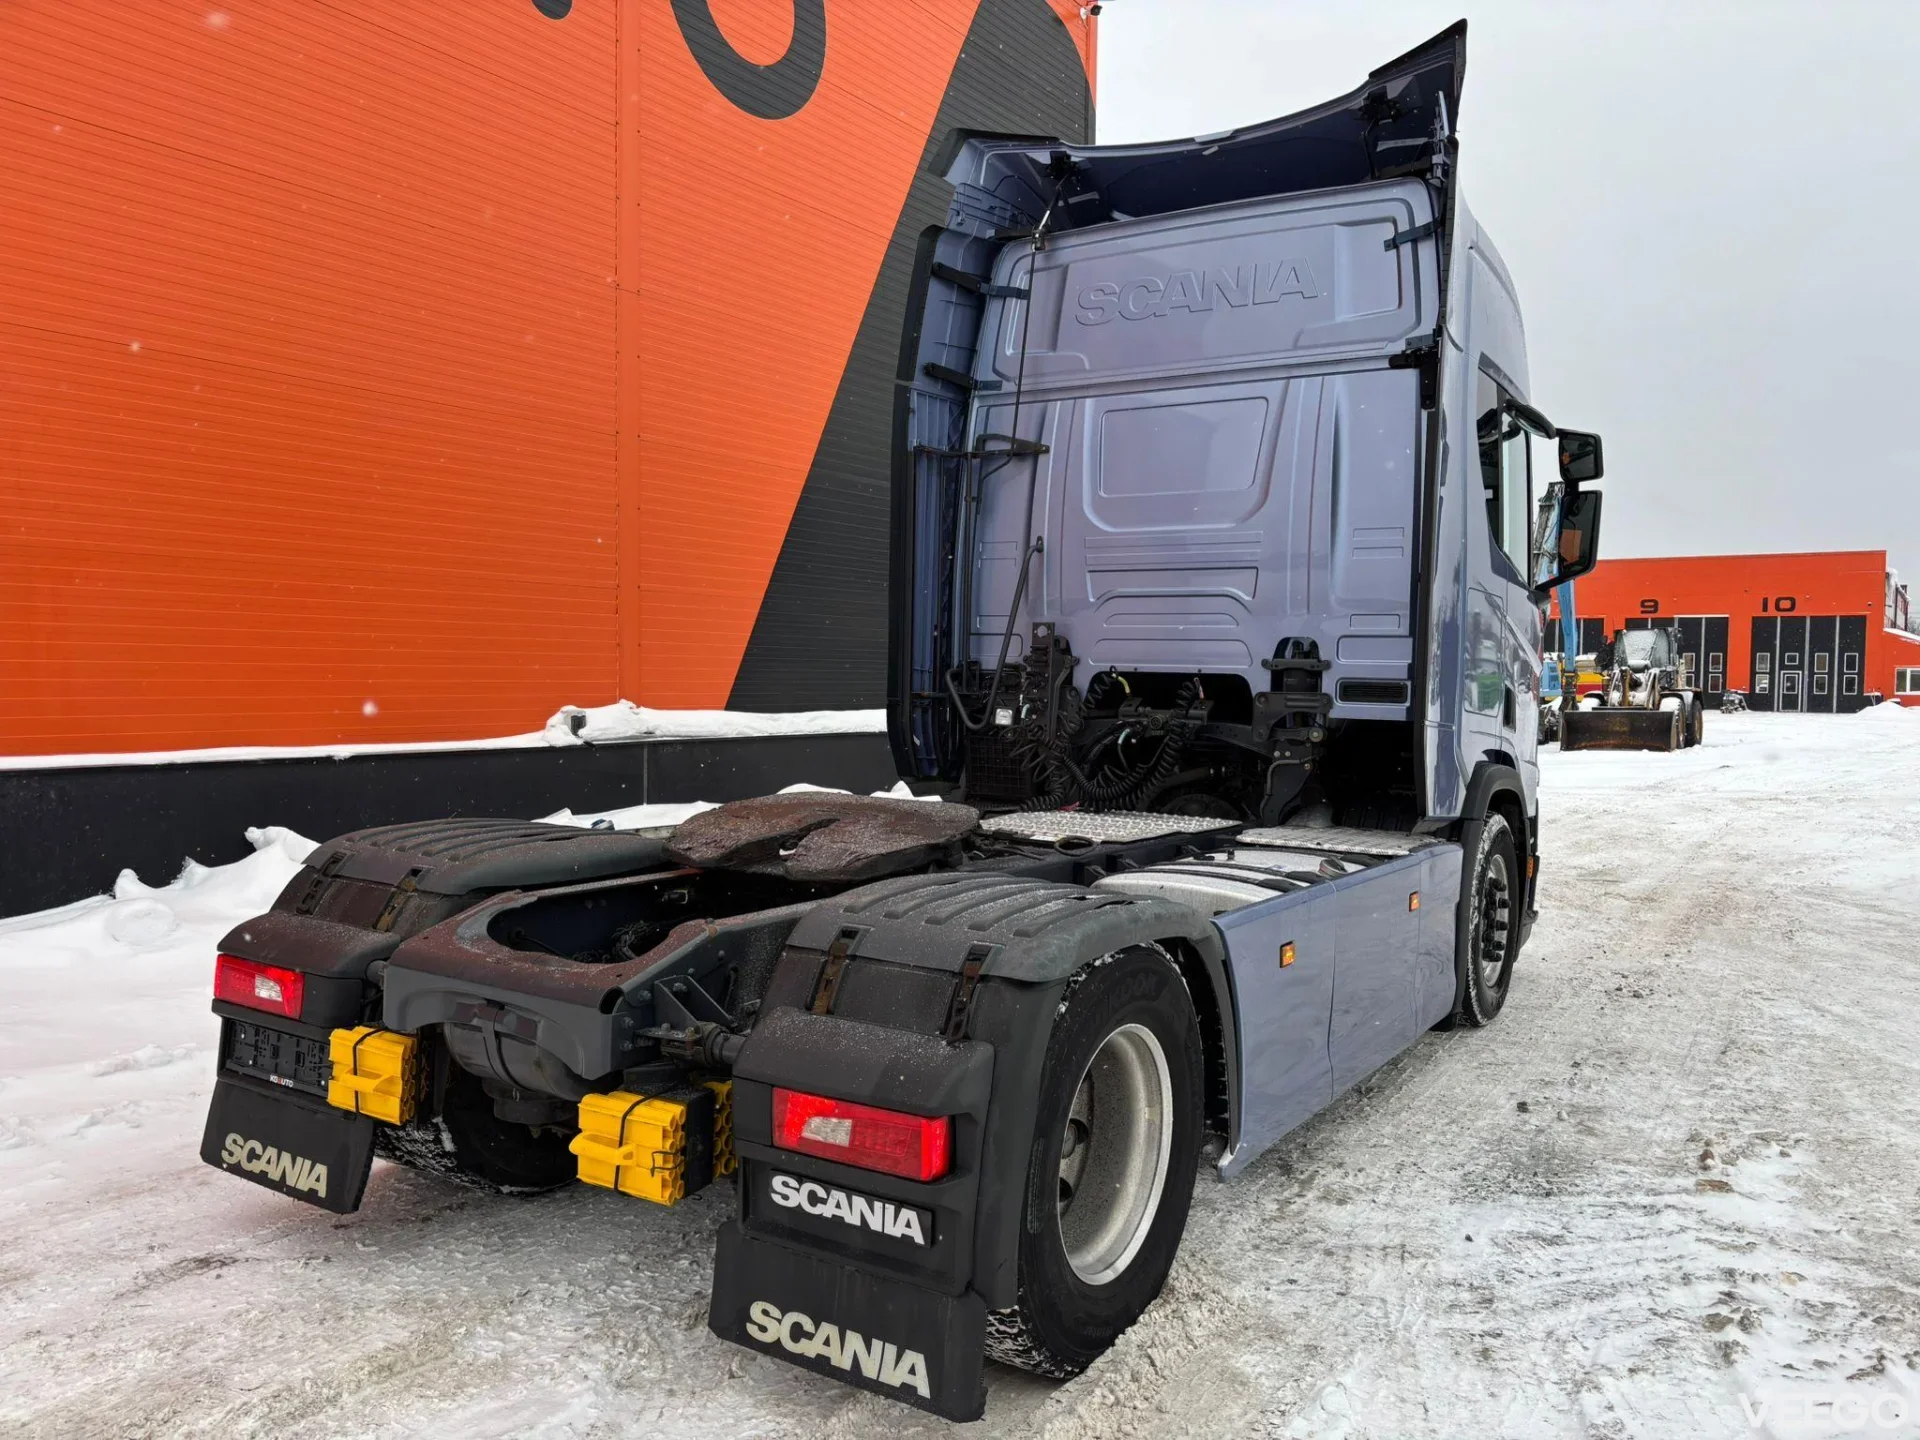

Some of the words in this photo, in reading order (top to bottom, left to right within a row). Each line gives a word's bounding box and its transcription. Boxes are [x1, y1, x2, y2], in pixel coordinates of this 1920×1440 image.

[1075, 257, 1319, 326] SCANIA
[1640, 598, 1659, 614] 9
[1761, 596, 1796, 613] 10
[221, 1132, 328, 1198] SCANIA
[770, 1175, 925, 1245] SCANIA
[746, 1301, 931, 1400] SCANIA
